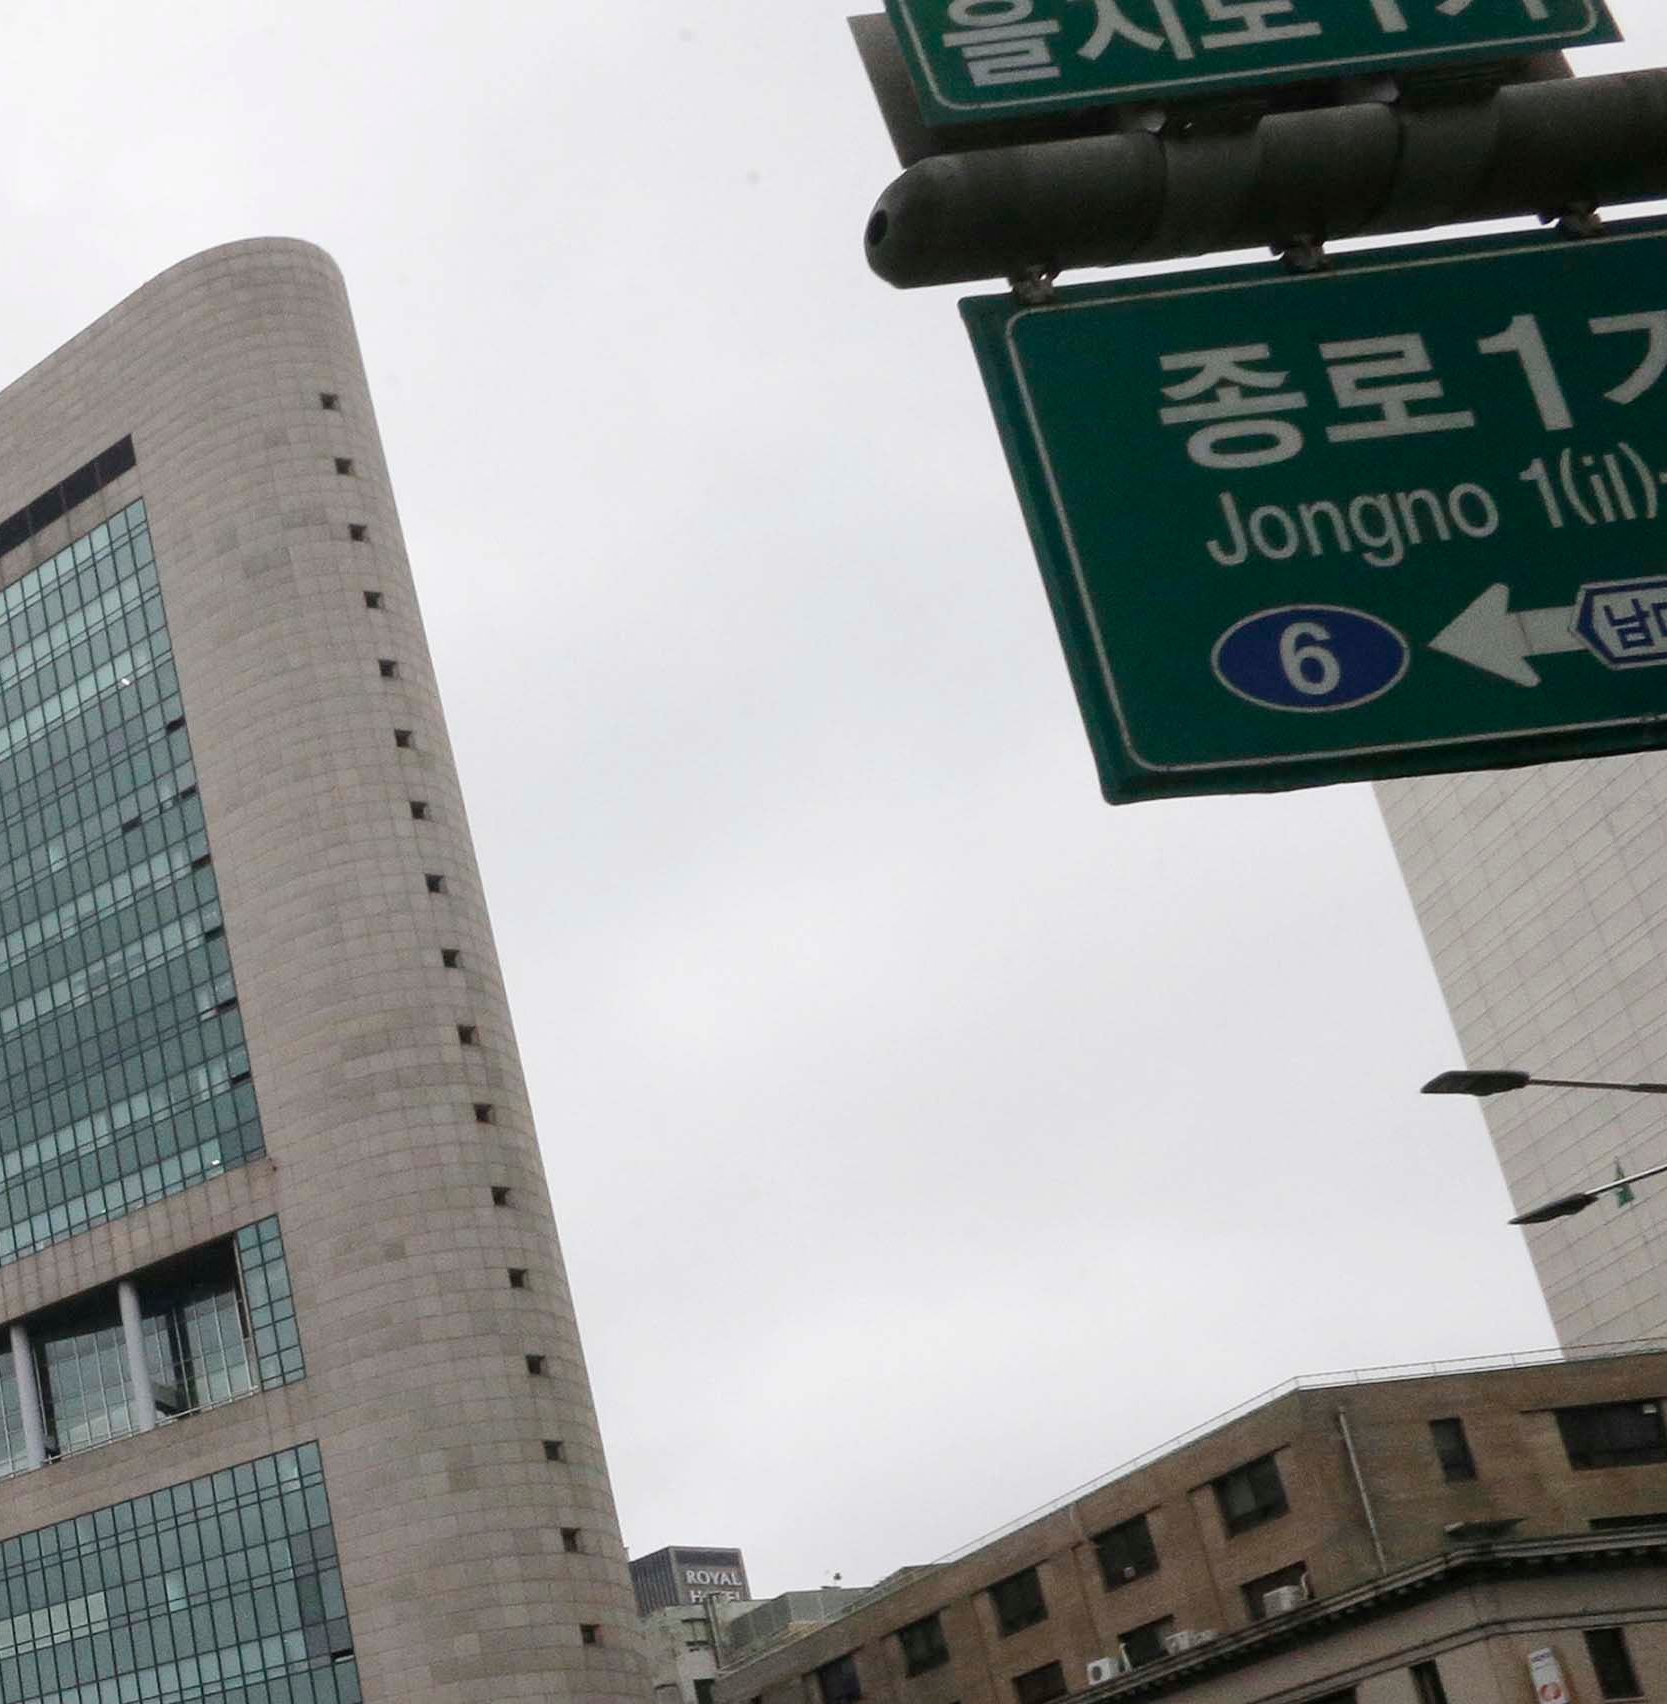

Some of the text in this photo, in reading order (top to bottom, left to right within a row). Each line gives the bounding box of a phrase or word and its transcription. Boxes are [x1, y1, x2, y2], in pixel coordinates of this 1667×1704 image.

[1205, 482, 1499, 568] Jongno
[1278, 621, 1343, 697] 6
[686, 1570, 743, 1585] ROYAL
